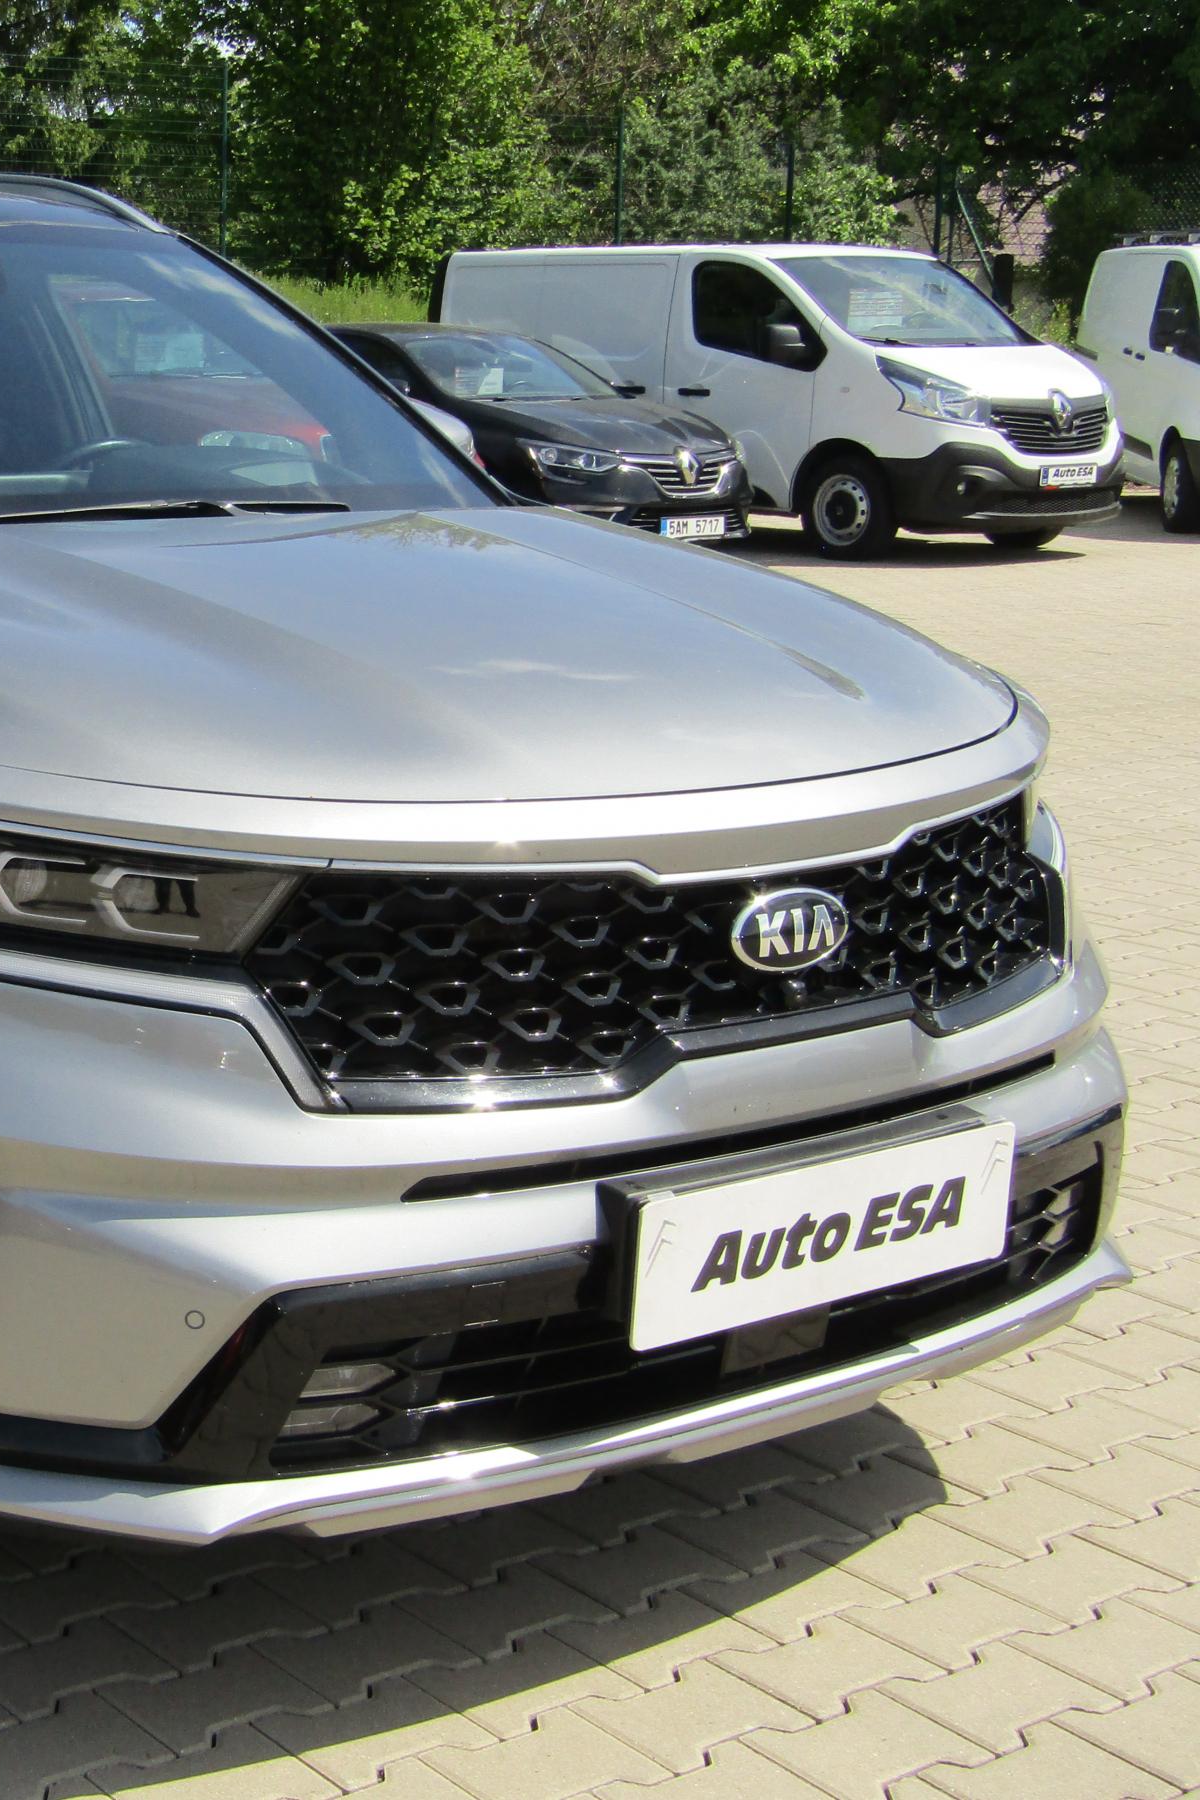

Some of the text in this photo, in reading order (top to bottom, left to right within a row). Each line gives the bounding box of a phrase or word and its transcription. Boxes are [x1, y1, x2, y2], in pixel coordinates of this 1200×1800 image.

[1052, 466, 1094, 478] Auto ESA
[669, 518, 720, 535] 5AM 5717
[756, 904, 834, 958] KIA
[691, 1176, 966, 1293] Auto ESA
